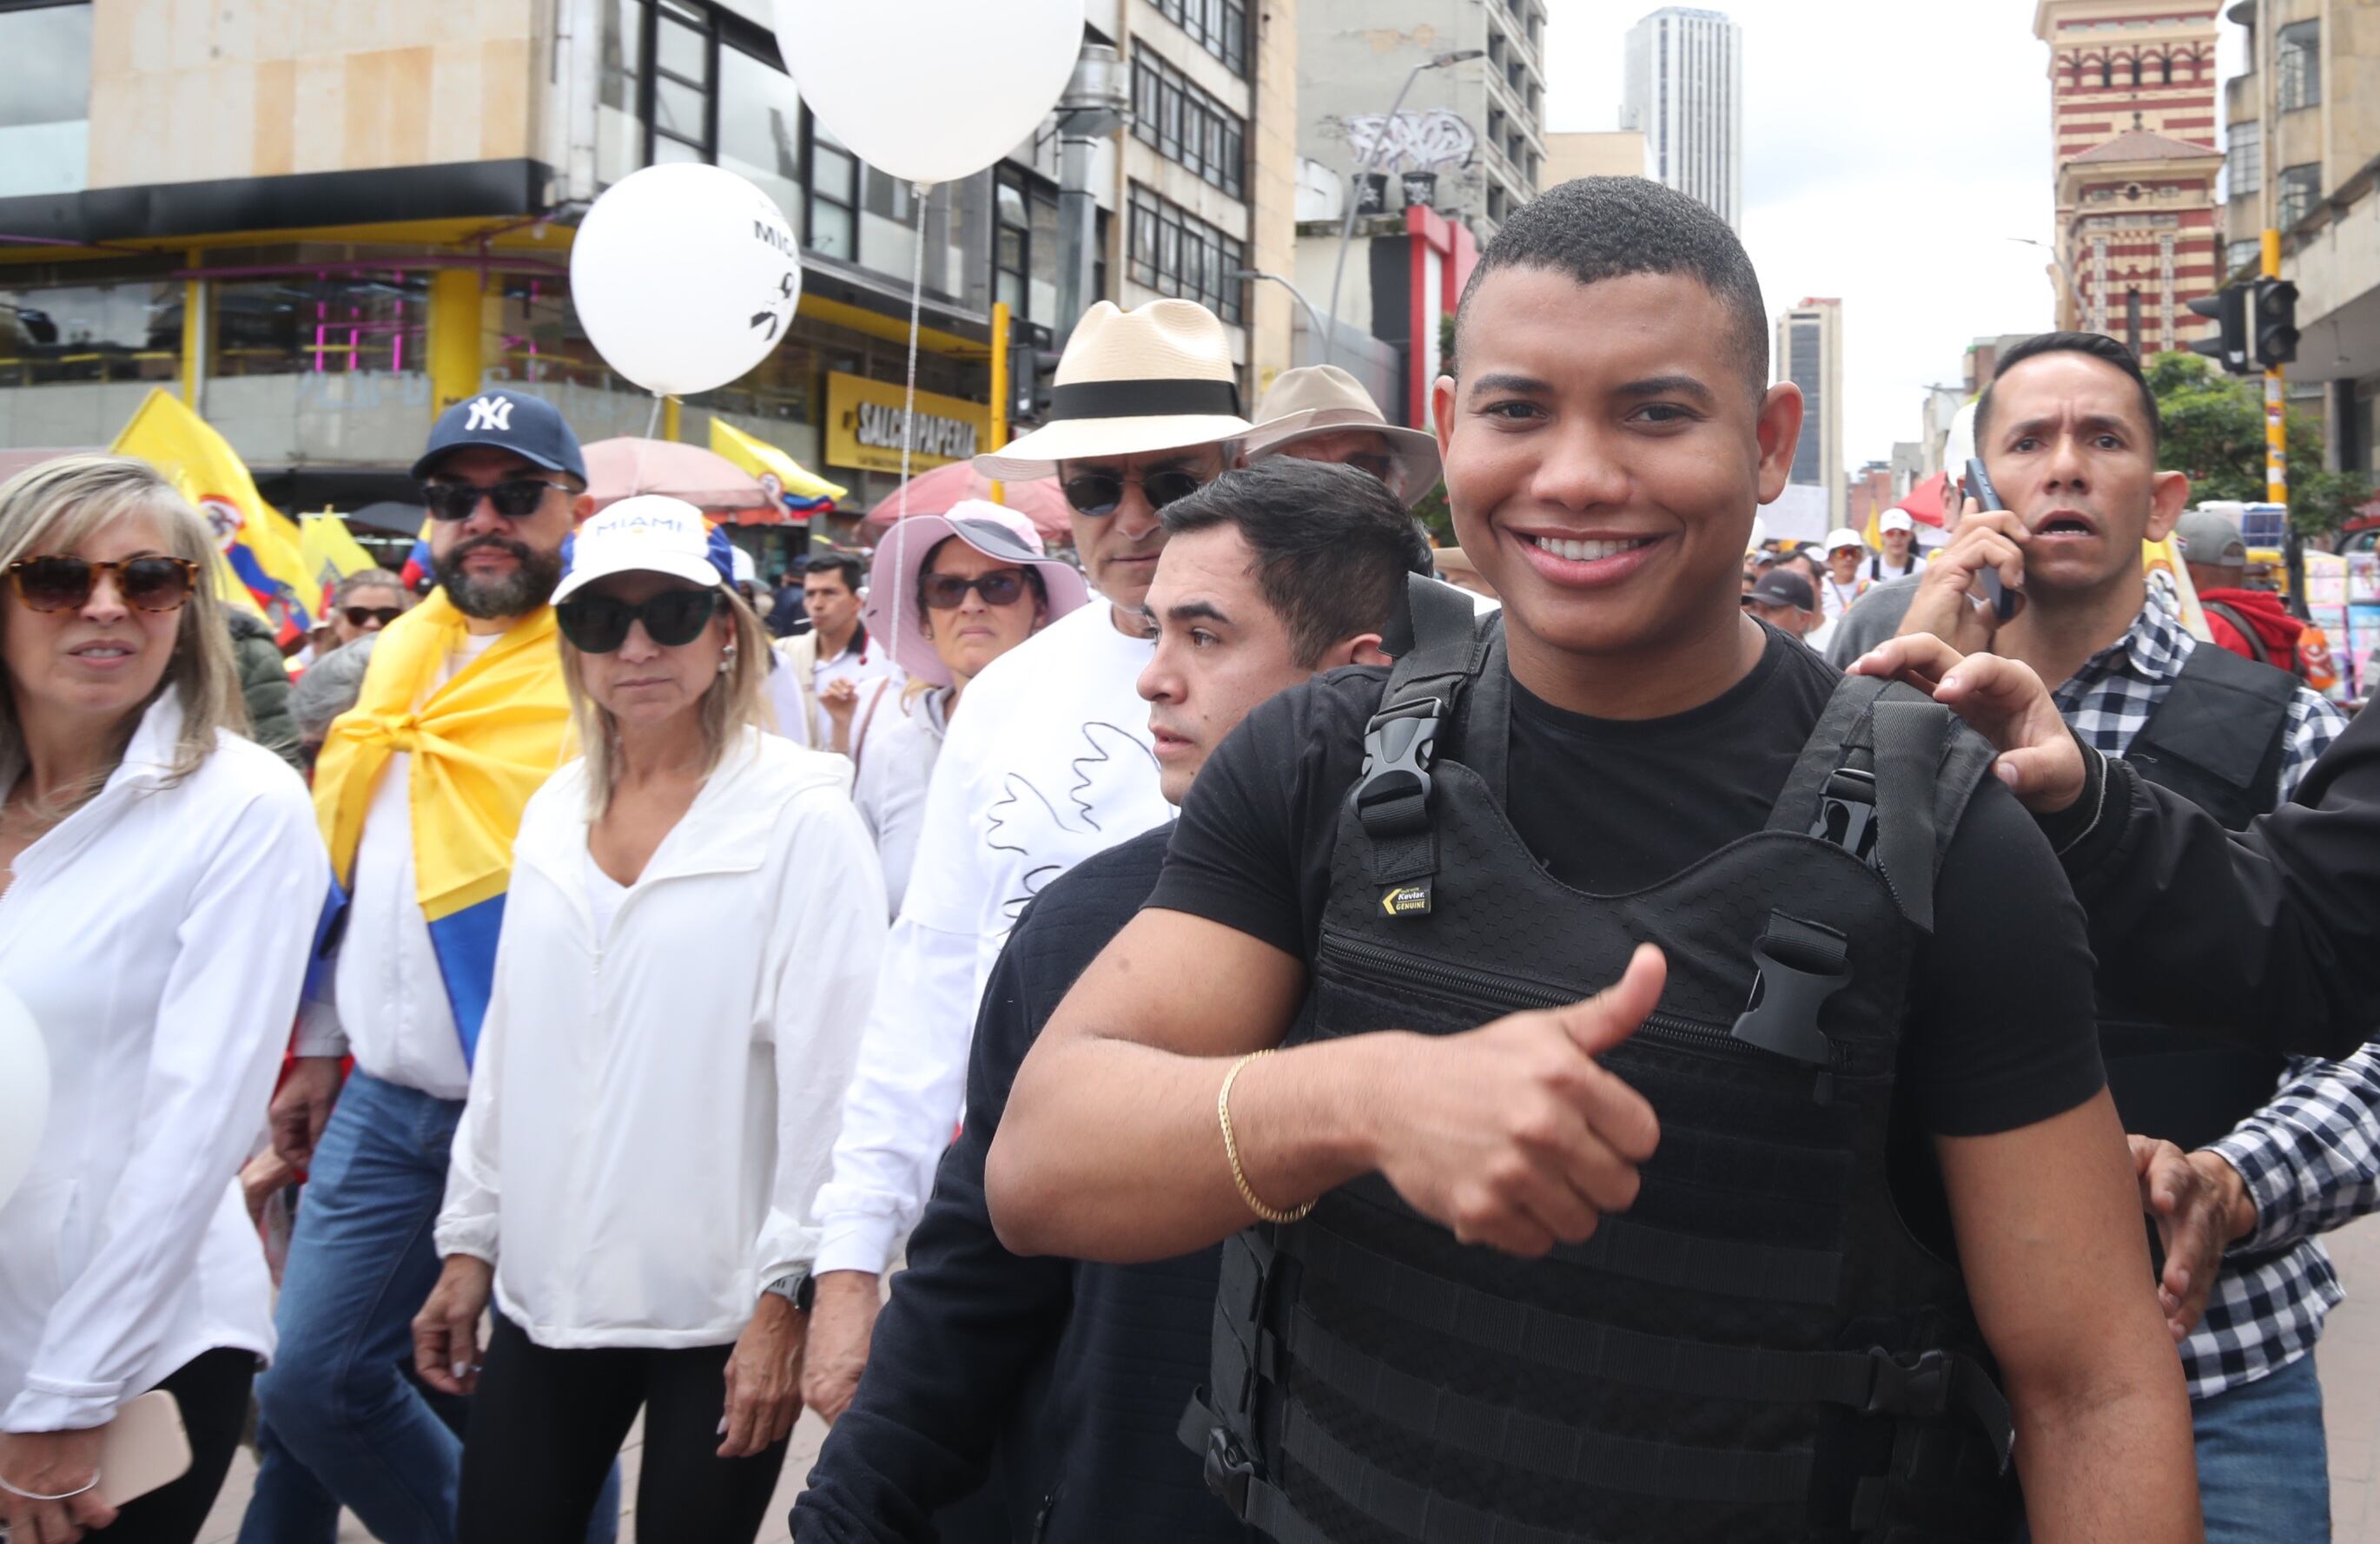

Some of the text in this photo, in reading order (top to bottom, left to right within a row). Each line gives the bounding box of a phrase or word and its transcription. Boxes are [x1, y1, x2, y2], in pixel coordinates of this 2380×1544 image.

[464, 396, 515, 432] NY
[597, 517, 683, 537] MIAMI
[1396, 901, 1425, 910] GENUINE
